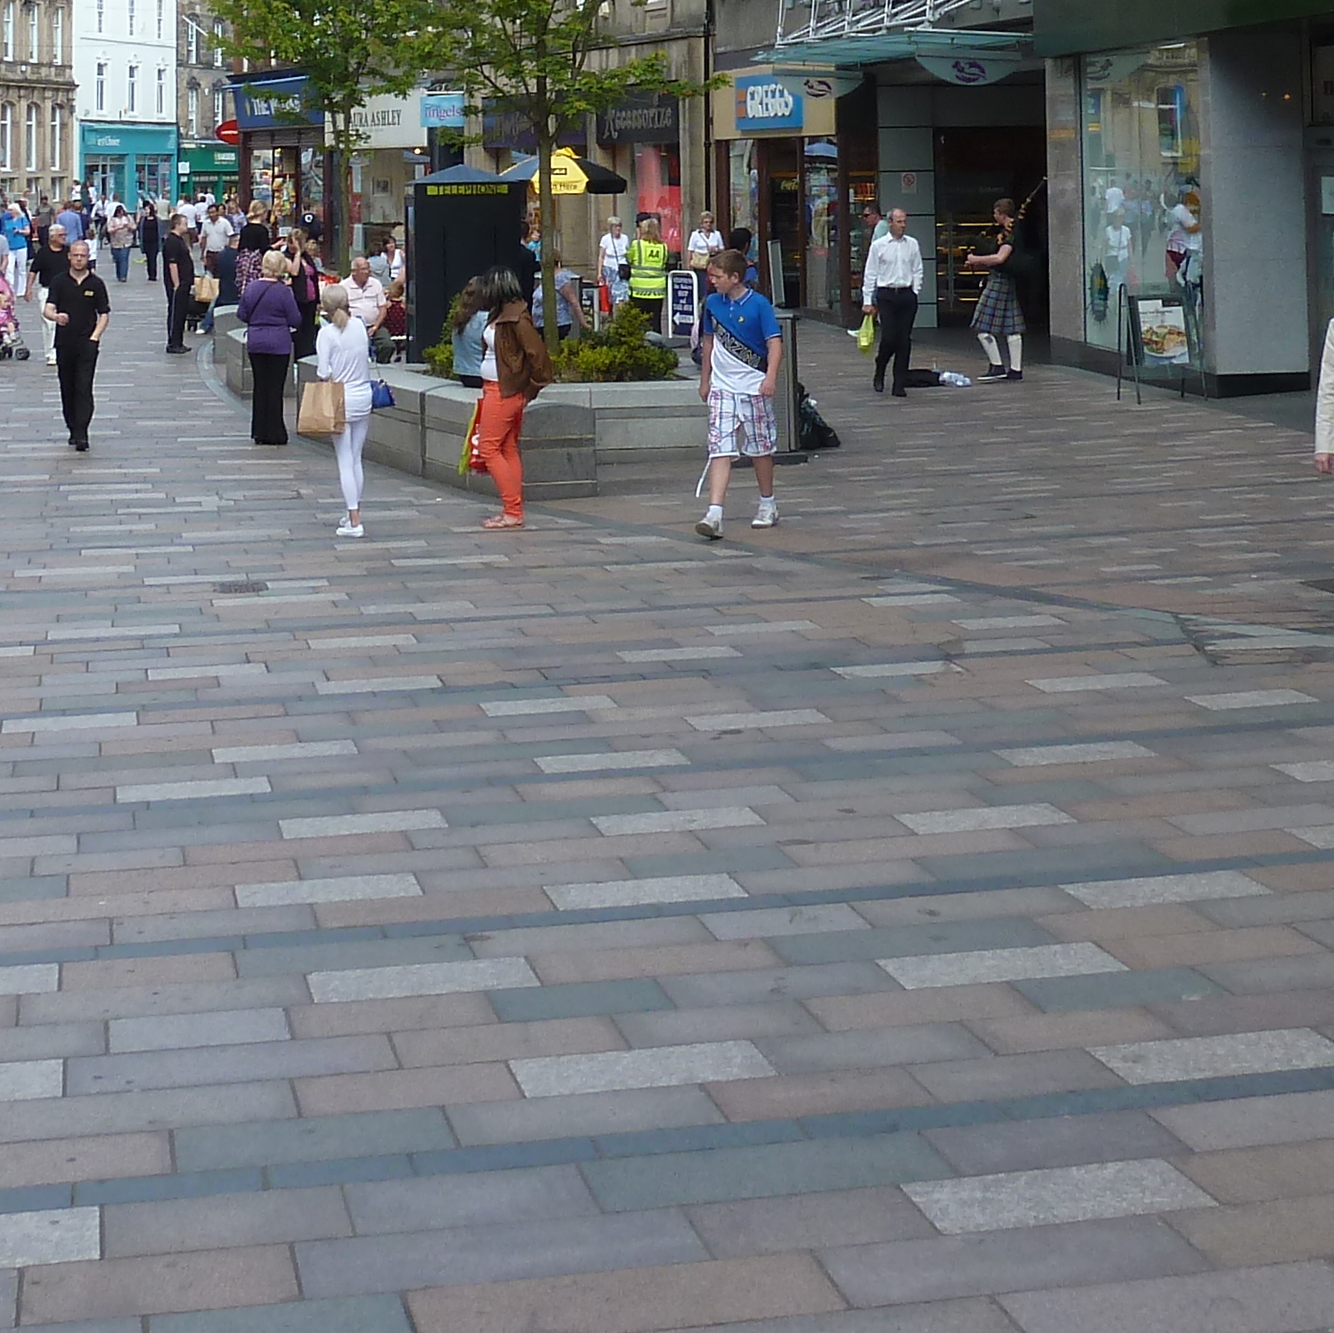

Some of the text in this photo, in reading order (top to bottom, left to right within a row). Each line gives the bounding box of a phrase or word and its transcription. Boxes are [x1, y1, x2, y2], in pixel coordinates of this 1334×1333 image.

[747, 83, 794, 118] GREGGS
[370, 109, 403, 127] ASHLEY
[648, 249, 660, 258] AA
